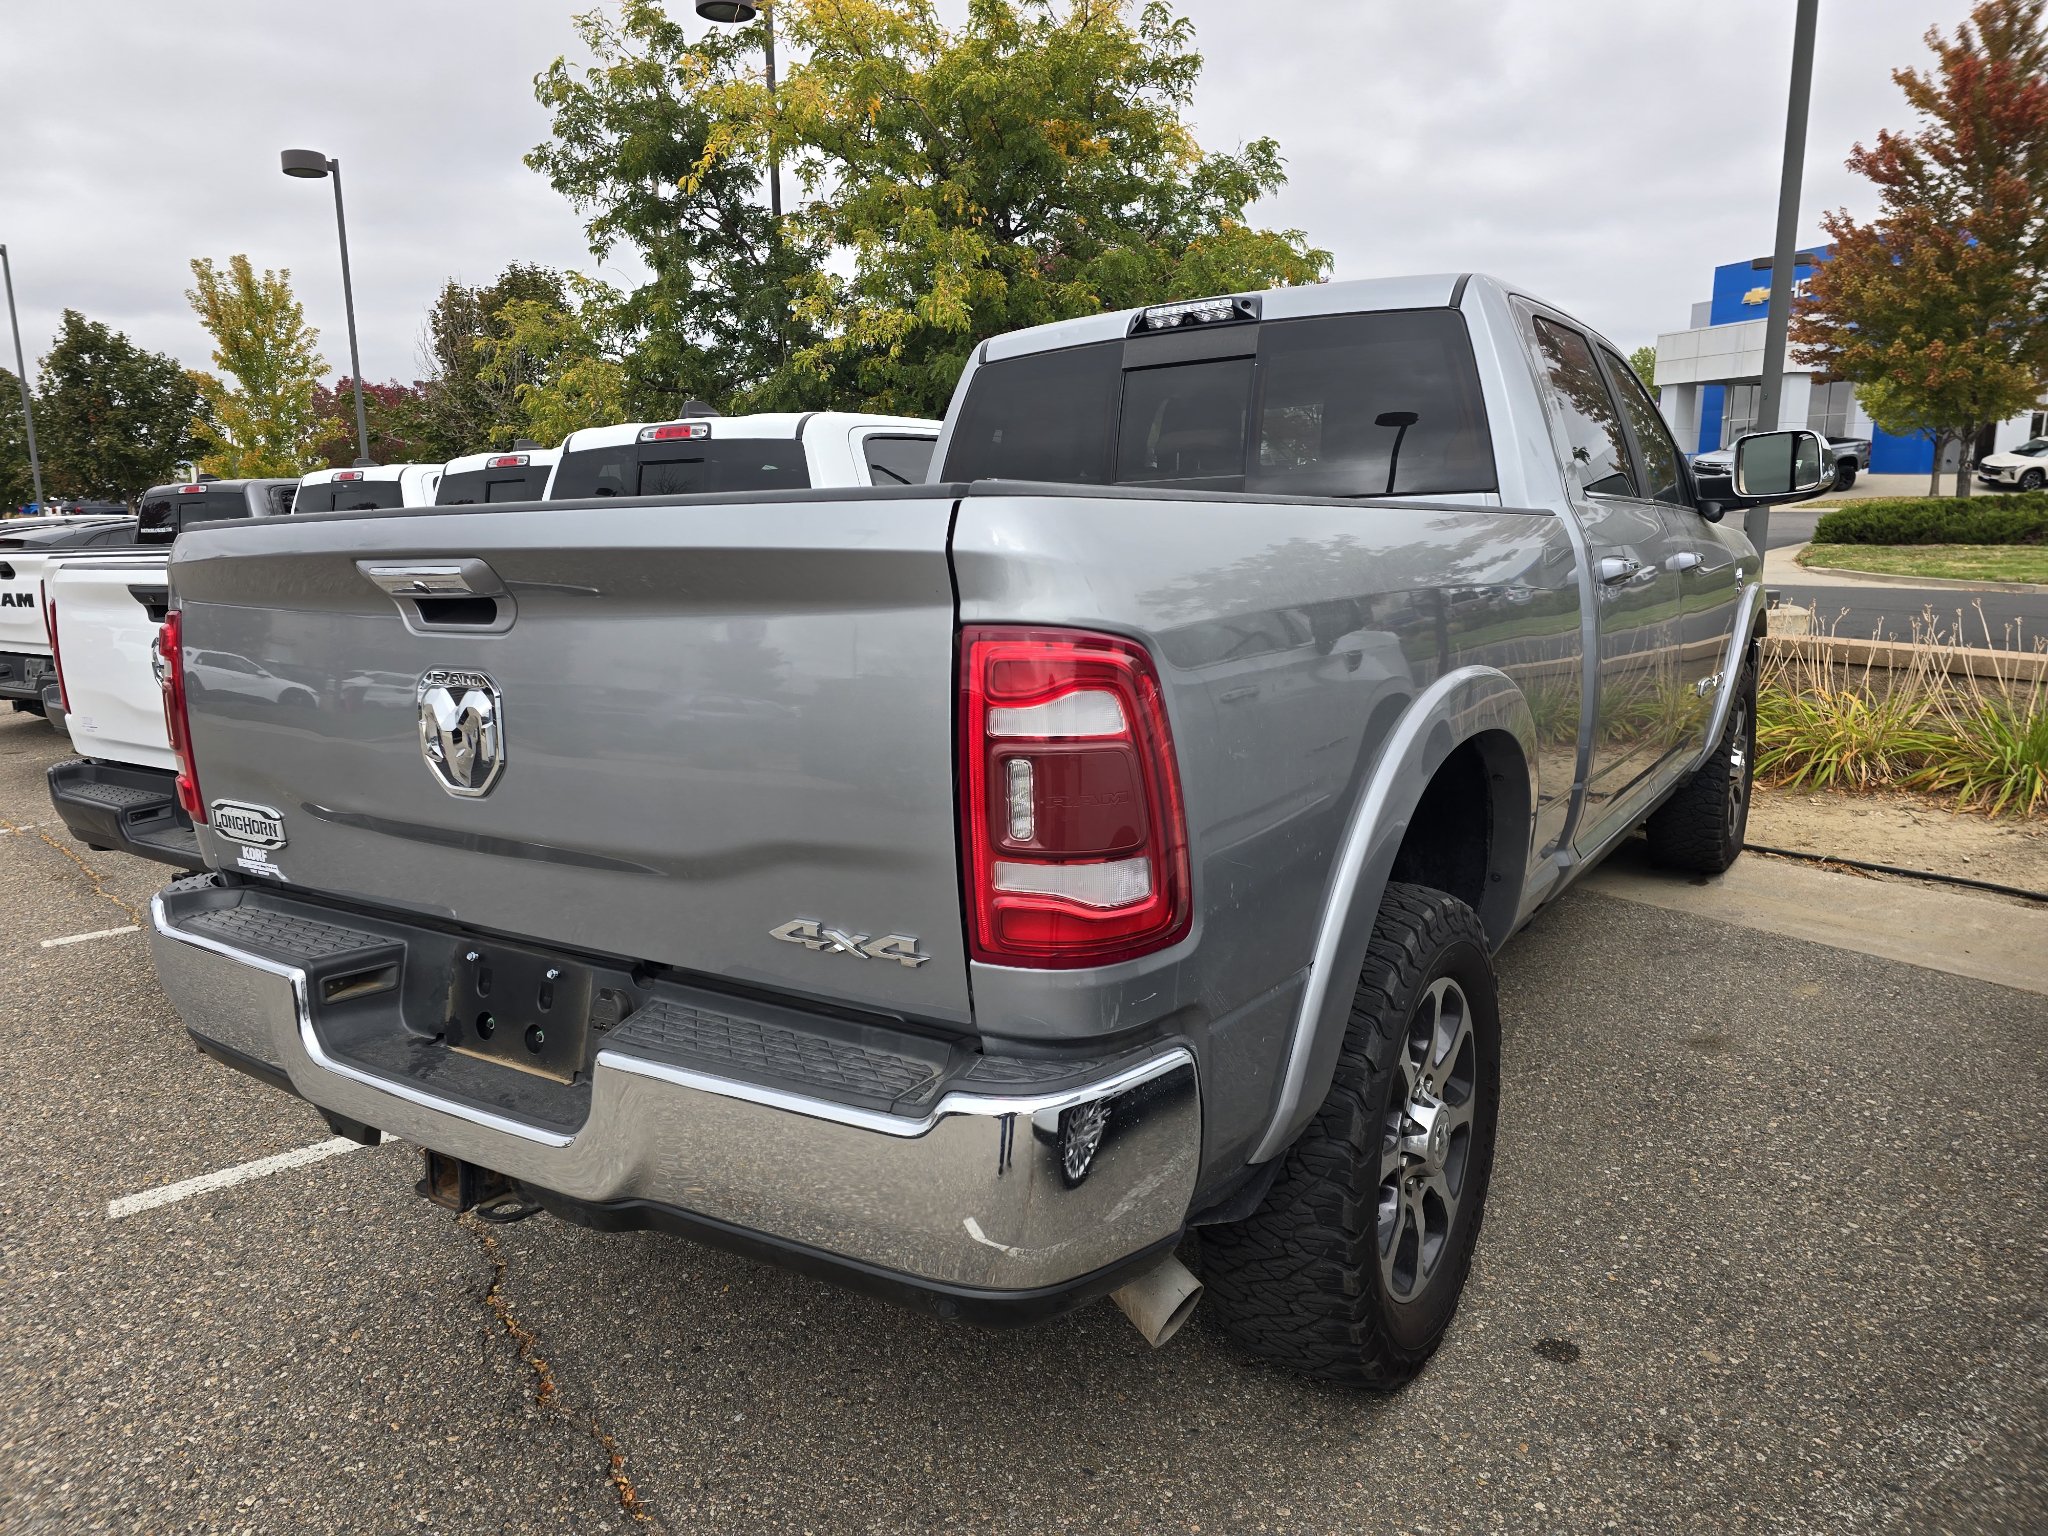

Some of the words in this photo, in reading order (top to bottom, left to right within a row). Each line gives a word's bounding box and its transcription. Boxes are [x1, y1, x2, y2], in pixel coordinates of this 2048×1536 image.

[0, 593, 35, 608] AM
[430, 672, 486, 688] RAM
[241, 845, 267, 862] KORF
